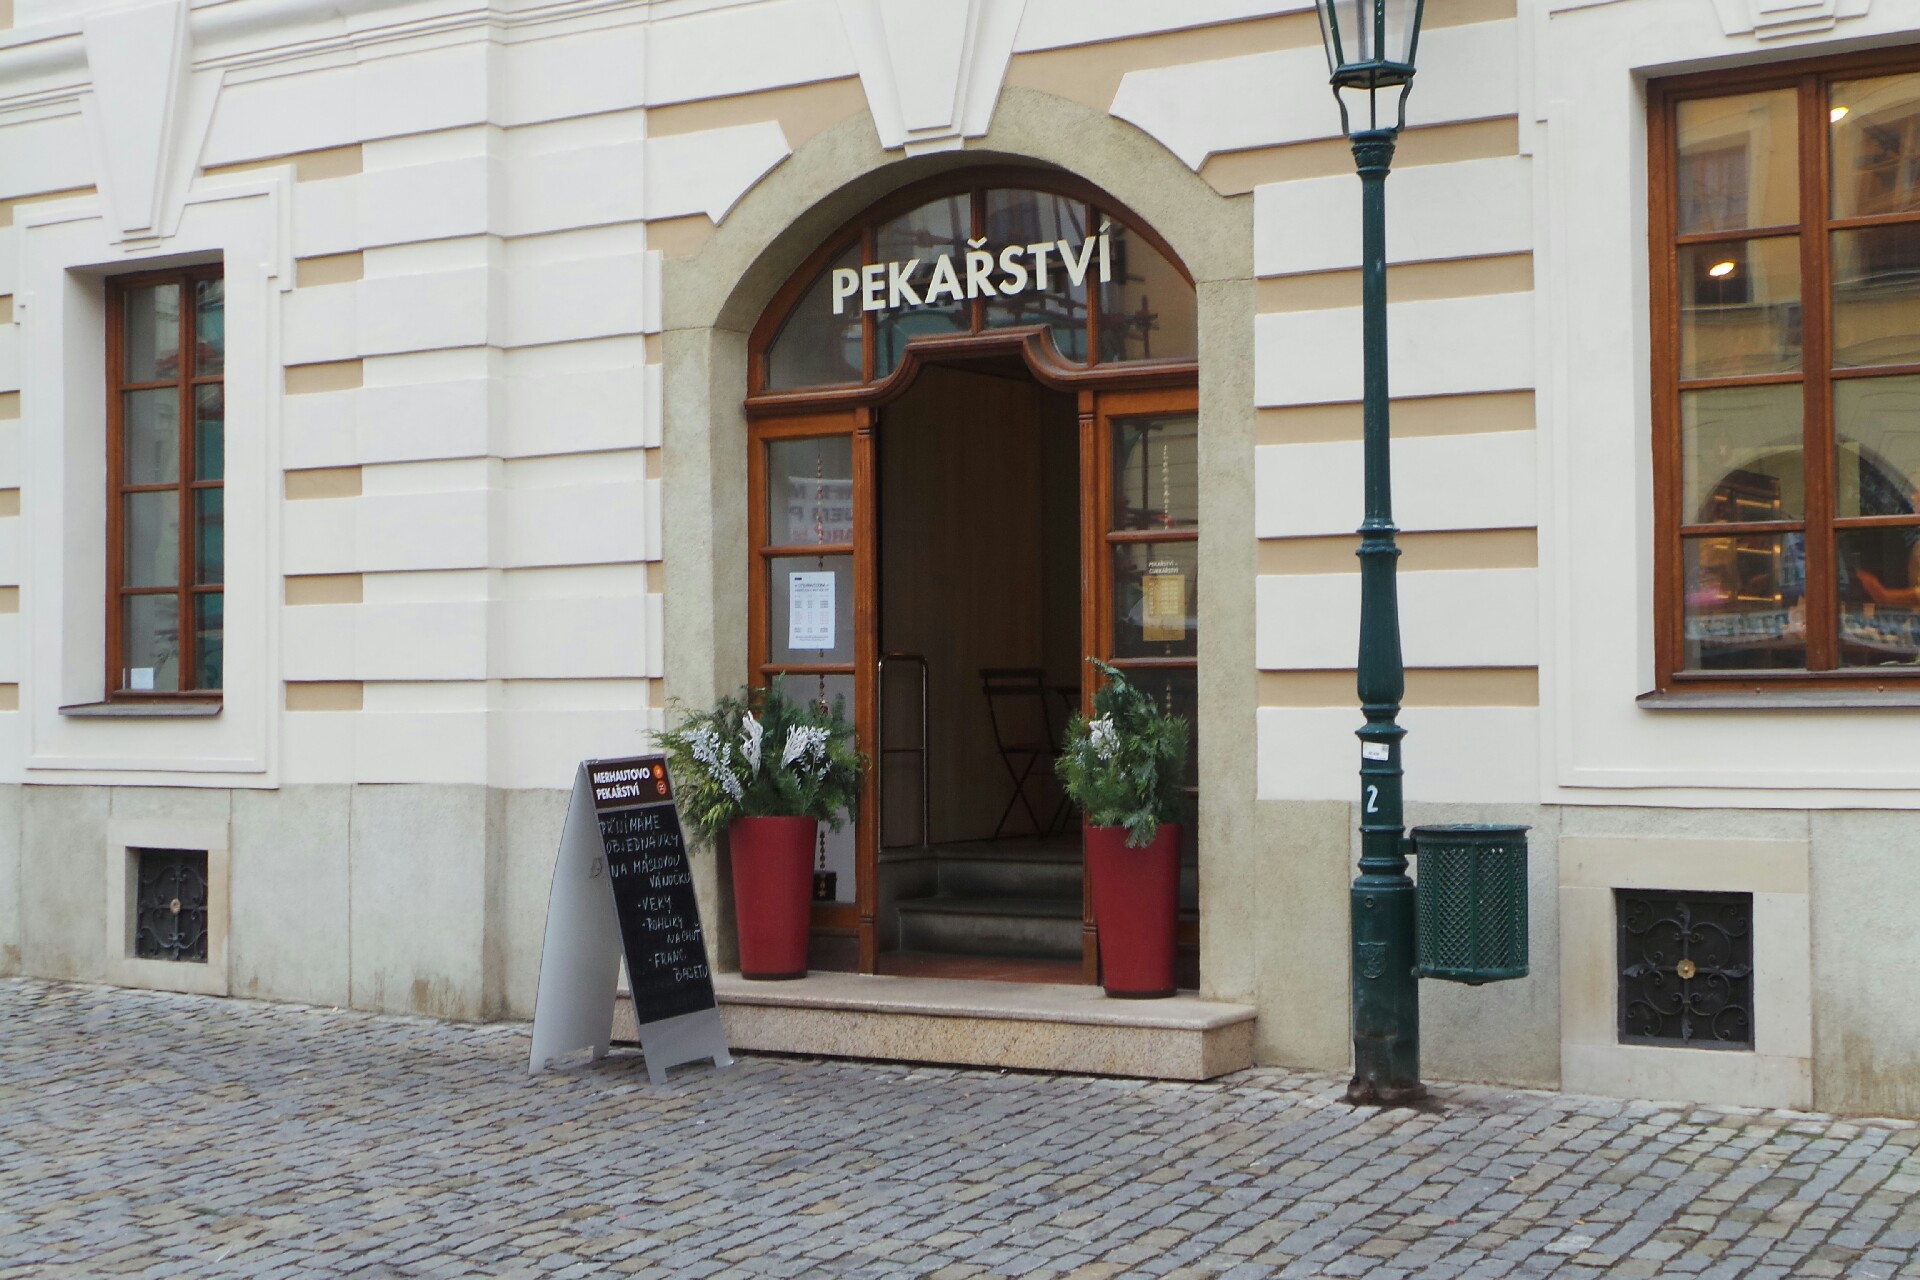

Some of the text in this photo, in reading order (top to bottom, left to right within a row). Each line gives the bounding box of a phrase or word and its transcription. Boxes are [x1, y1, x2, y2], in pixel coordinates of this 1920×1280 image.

[833, 222, 1111, 314] PEKAŘSTVÍ
[593, 767, 651, 784] MERHAUTOVO
[596, 782, 640, 800] PEKAŘSTVÍ
[1366, 785, 1379, 813] 2
[606, 833, 679, 854] OBJEDNÁVKY
[610, 853, 681, 878] NA MÁSLOVOU
[666, 932, 681, 944] NA
